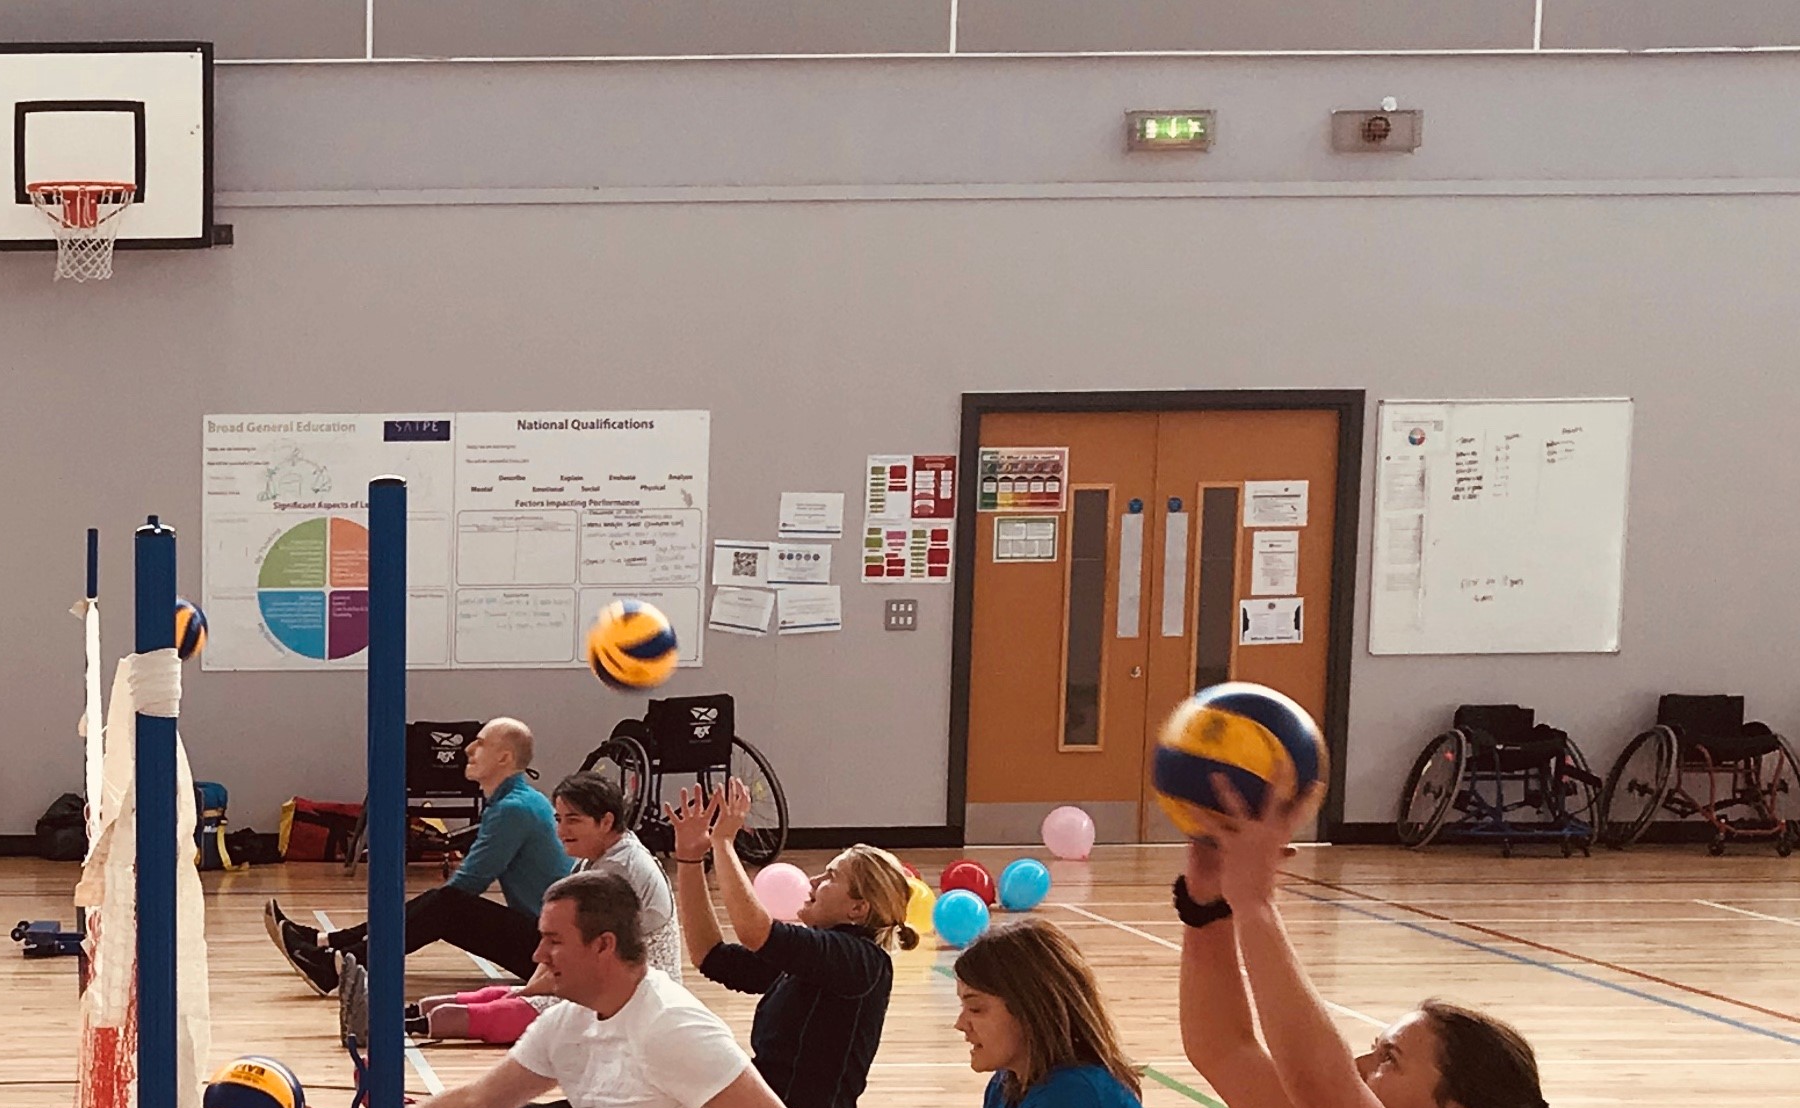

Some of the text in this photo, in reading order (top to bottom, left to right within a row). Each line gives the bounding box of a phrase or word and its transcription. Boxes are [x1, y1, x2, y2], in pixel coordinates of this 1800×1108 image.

[207, 421, 356, 433] Broad General Education
[517, 418, 655, 431] National Qualifications
[273, 502, 316, 511] Significant
[317, 501, 349, 510] Aspects
[350, 501, 359, 509] of
[546, 499, 587, 508] Impacting
[588, 499, 640, 507] Performance
